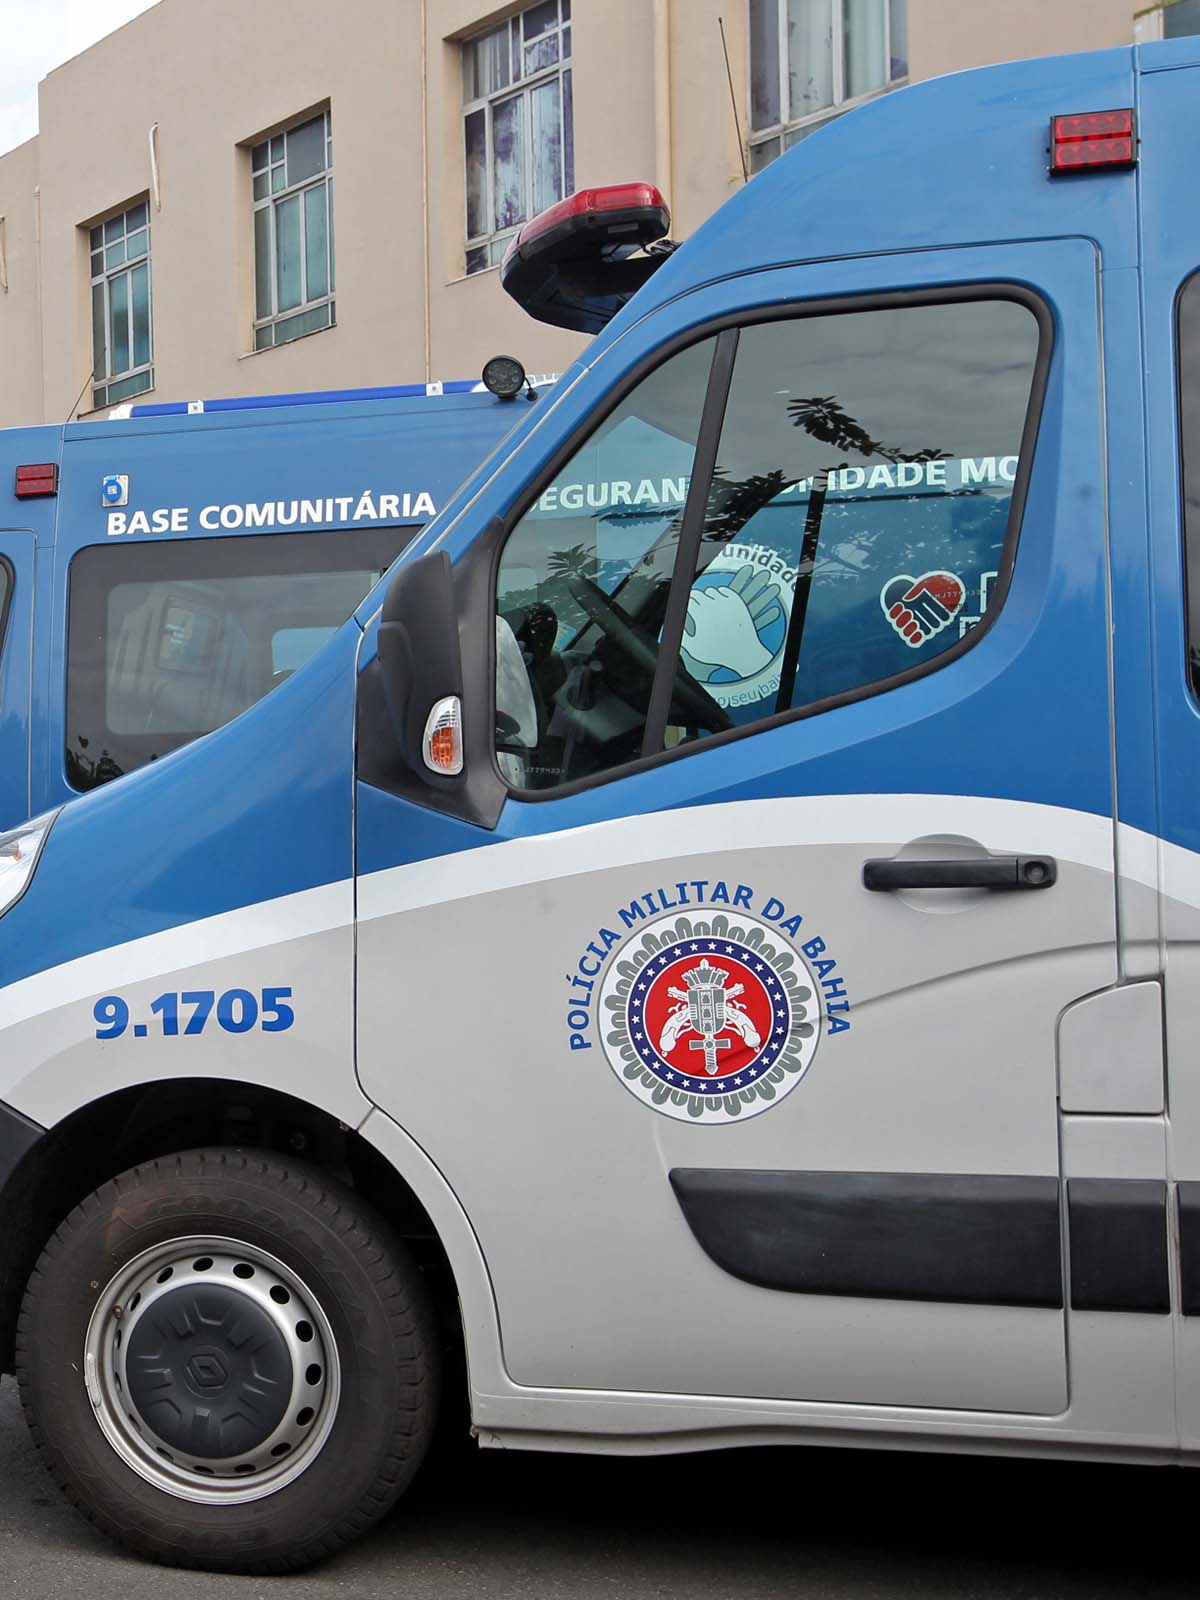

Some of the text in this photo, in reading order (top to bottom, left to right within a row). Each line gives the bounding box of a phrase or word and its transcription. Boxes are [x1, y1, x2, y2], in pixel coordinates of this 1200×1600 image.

[107, 489, 437, 536] BASE COMUNITÁRIA
[530, 477, 689, 512] EGURAN
[565, 880, 852, 1051] POLÍCIA MILITAR DA BAHIA
[93, 986, 295, 1040] 9.1705
